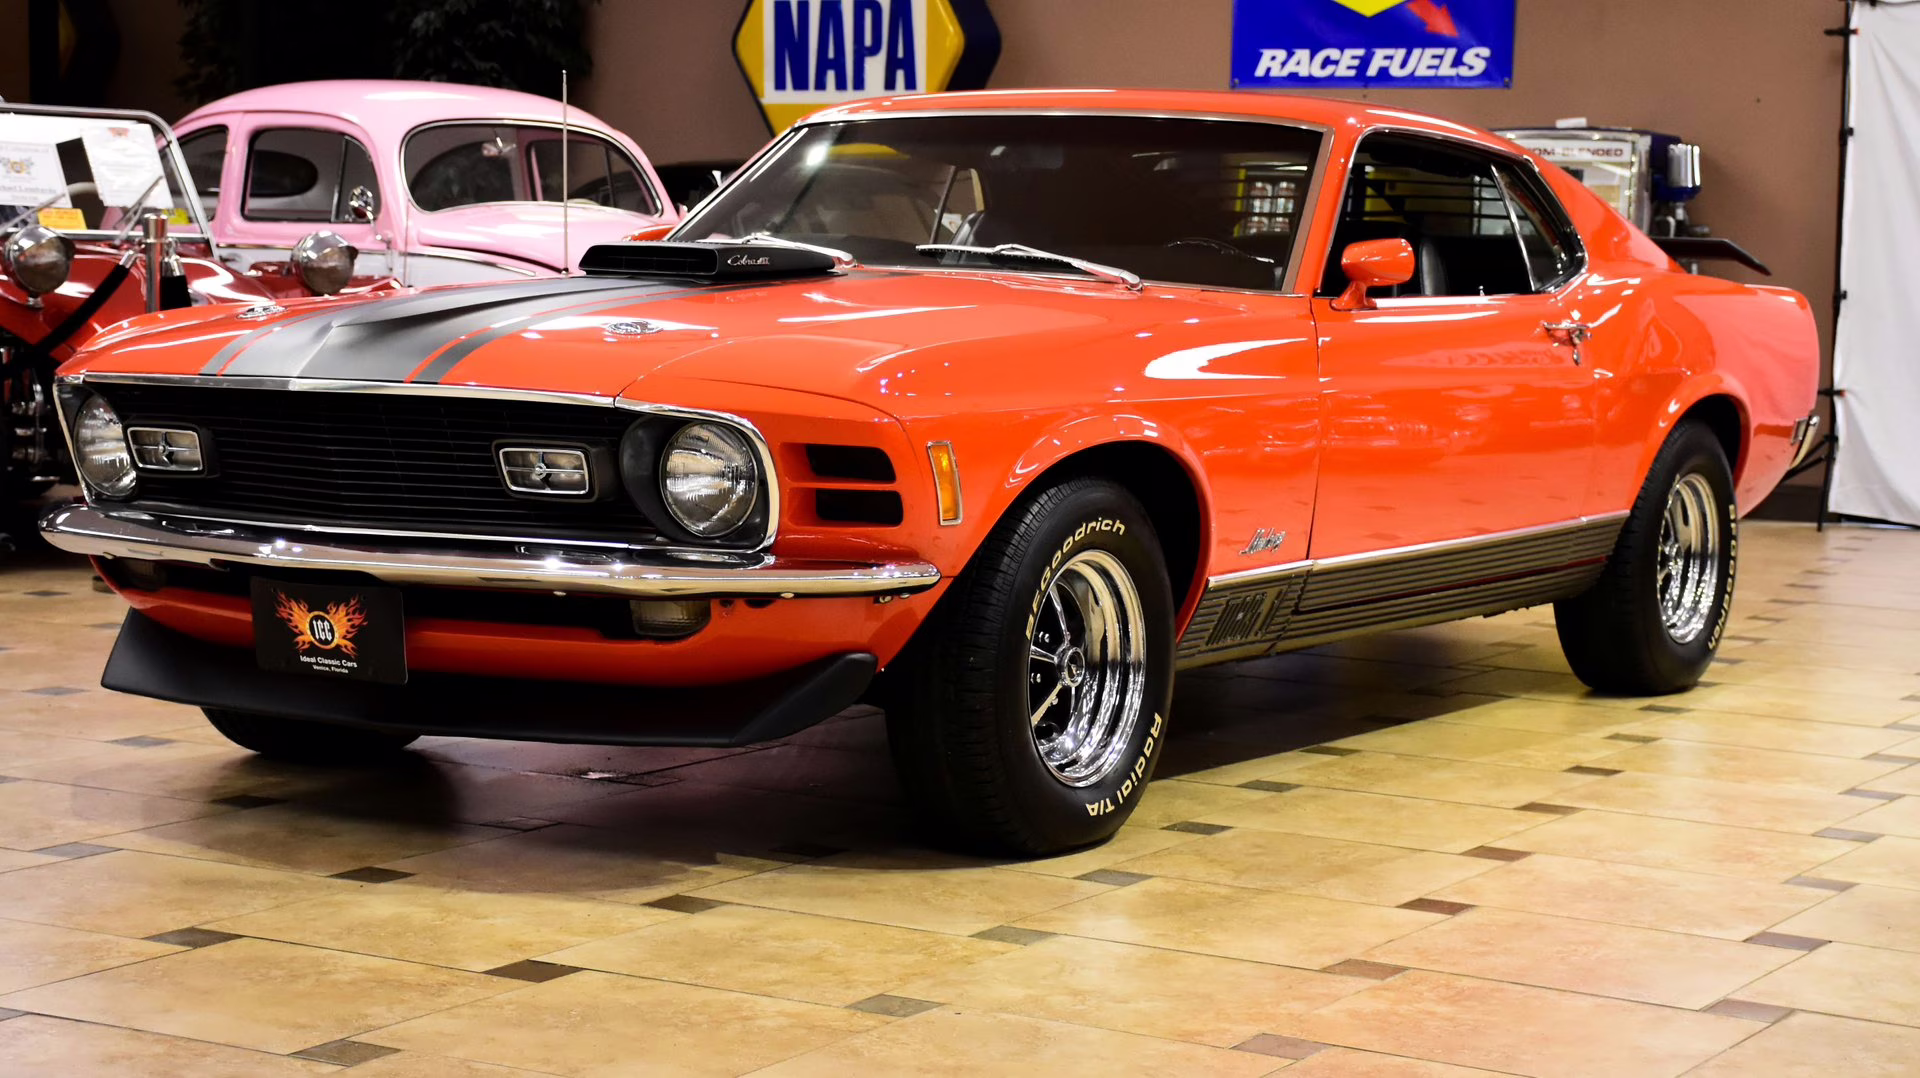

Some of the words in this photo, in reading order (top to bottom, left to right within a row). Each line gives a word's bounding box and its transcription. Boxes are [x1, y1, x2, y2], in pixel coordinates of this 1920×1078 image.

[774, 0, 917, 91] NAPA
[1254, 48, 1366, 78] RACE
[1366, 46, 1491, 78] FUELS
[1025, 517, 1126, 640] BFGoodrich
[312, 619, 332, 641] ICC
[300, 655, 317, 663] Ideal
[317, 656, 341, 665] Classic
[341, 660, 358, 668] Cars
[1116, 712, 1162, 805] Radial
[1085, 798, 1115, 816] T/A
